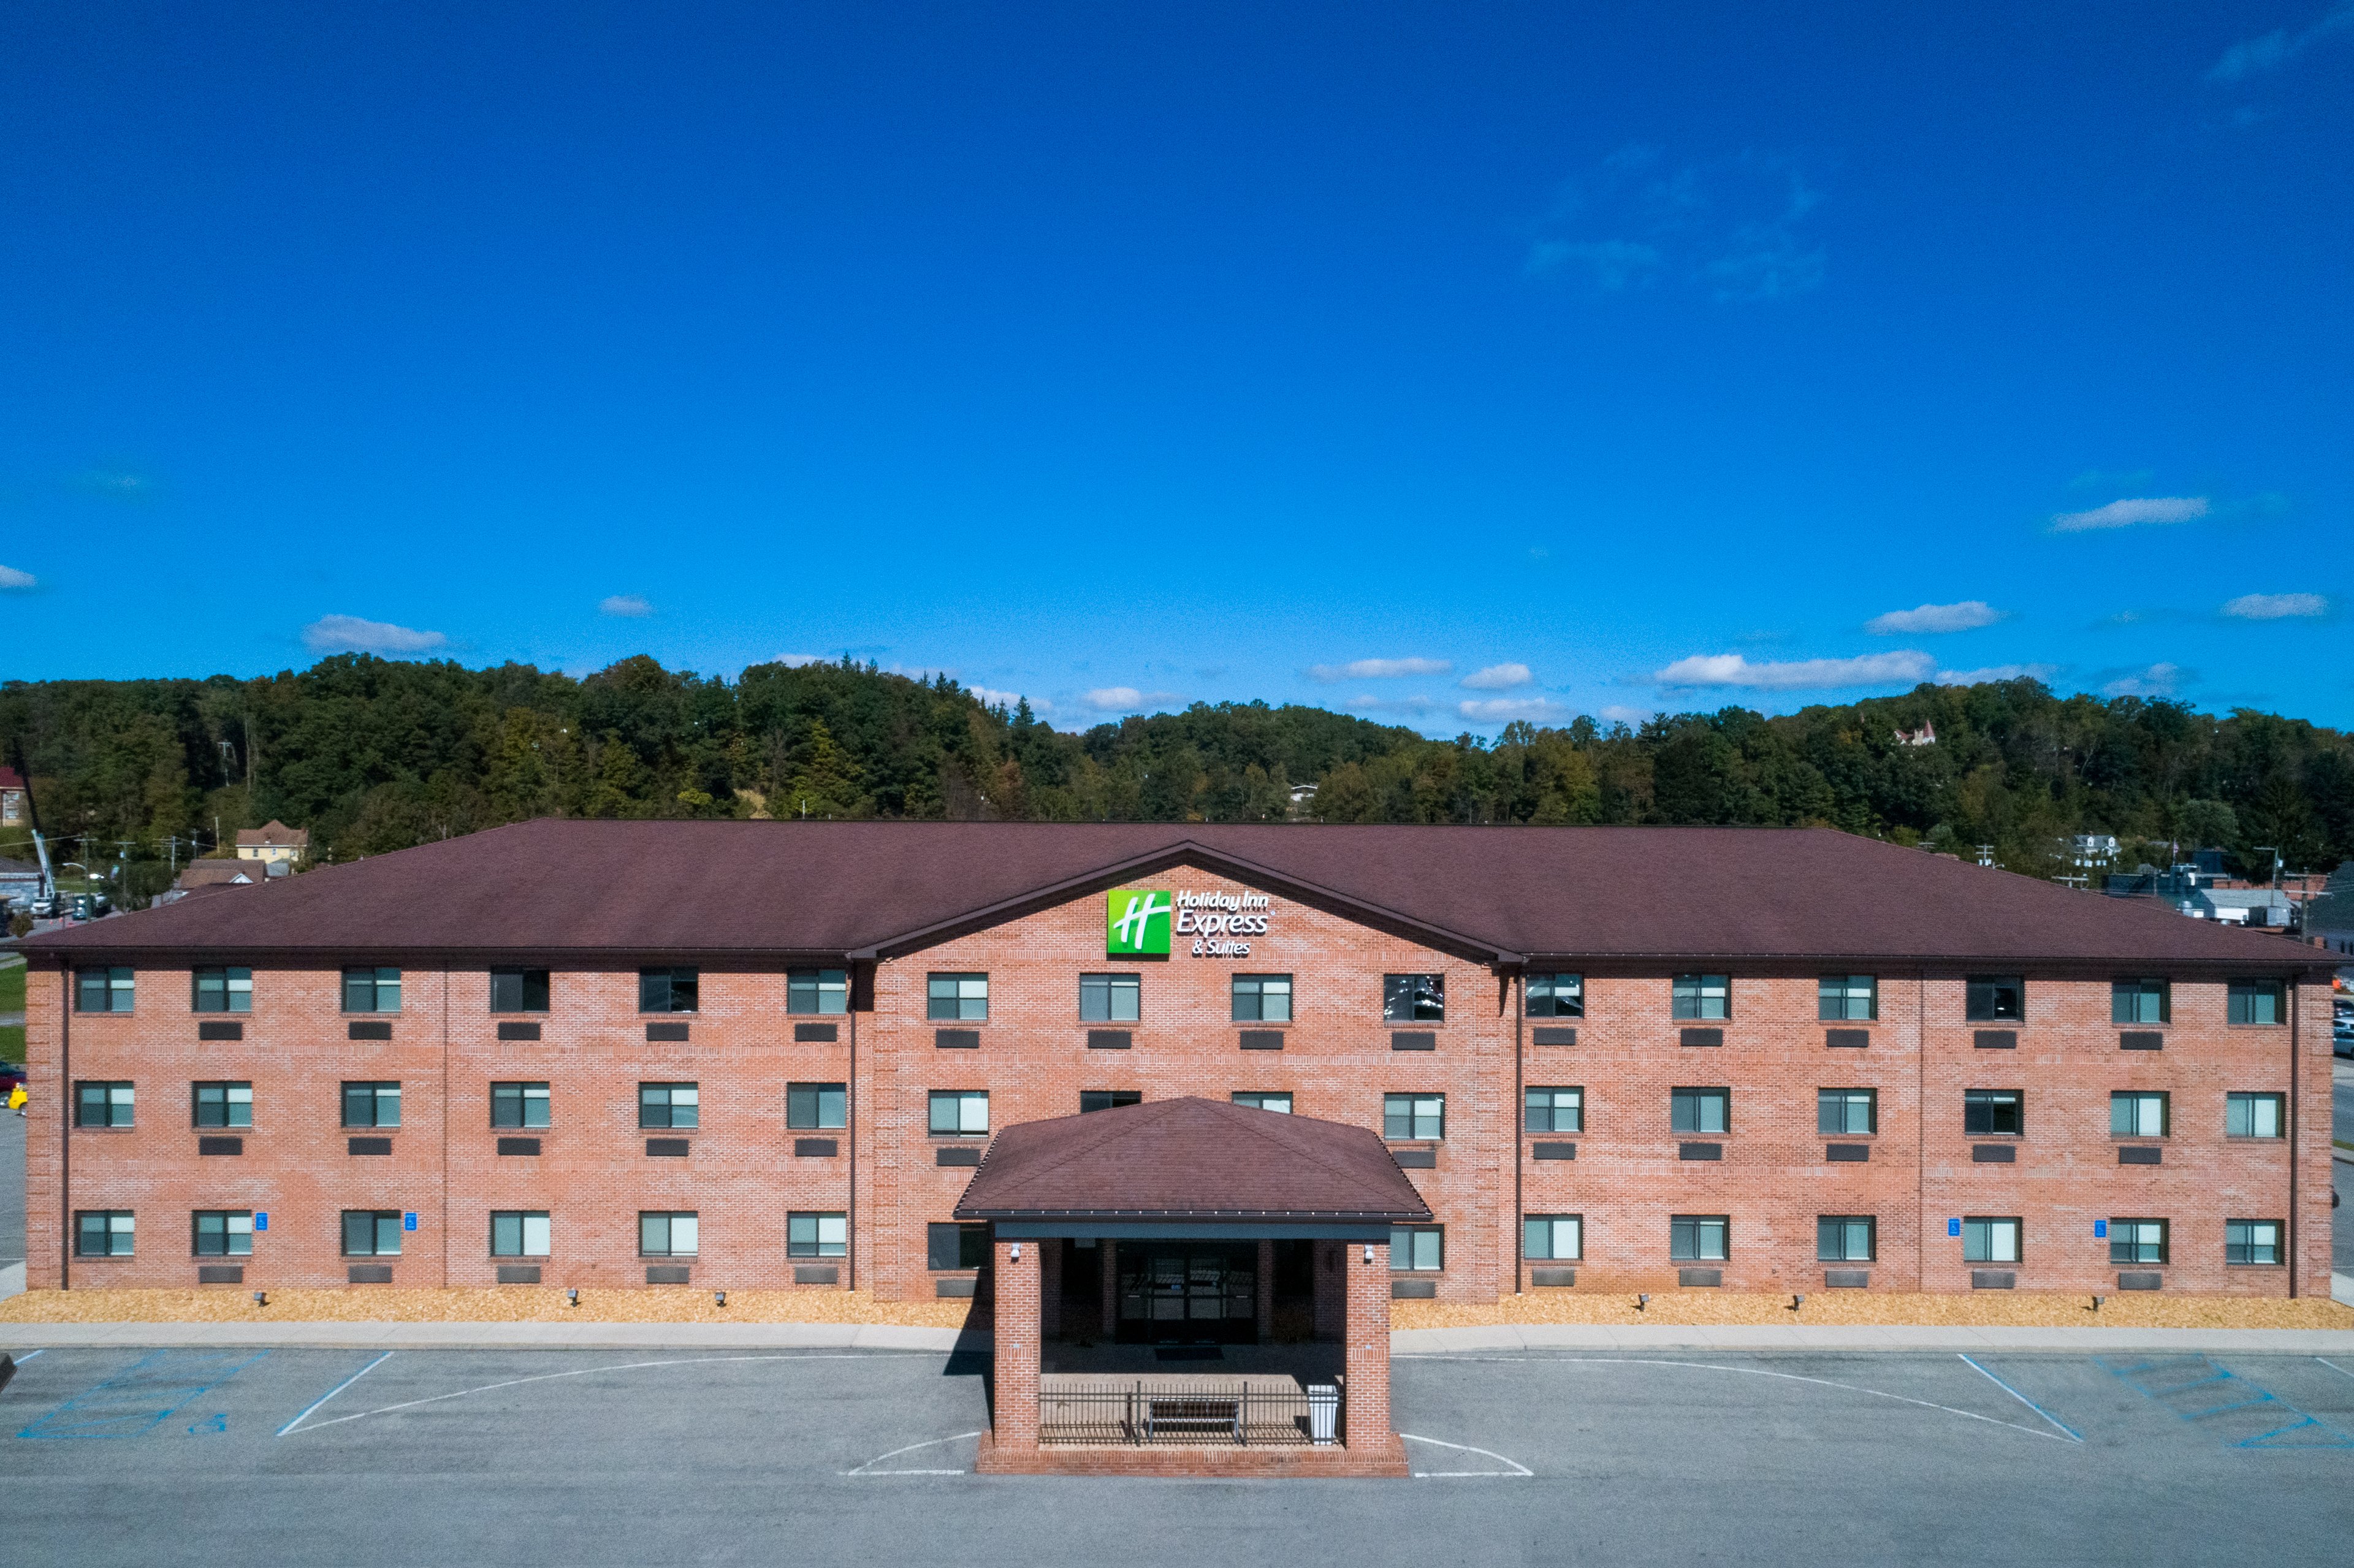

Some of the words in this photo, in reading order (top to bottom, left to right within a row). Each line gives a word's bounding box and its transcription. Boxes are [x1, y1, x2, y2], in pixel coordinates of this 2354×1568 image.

[1176, 890, 1241, 911] Holiday
[1243, 891, 1269, 907] Inn
[1176, 909, 1268, 938] Express
[1192, 940, 1203, 954] &
[1206, 940, 1251, 954] Suites
